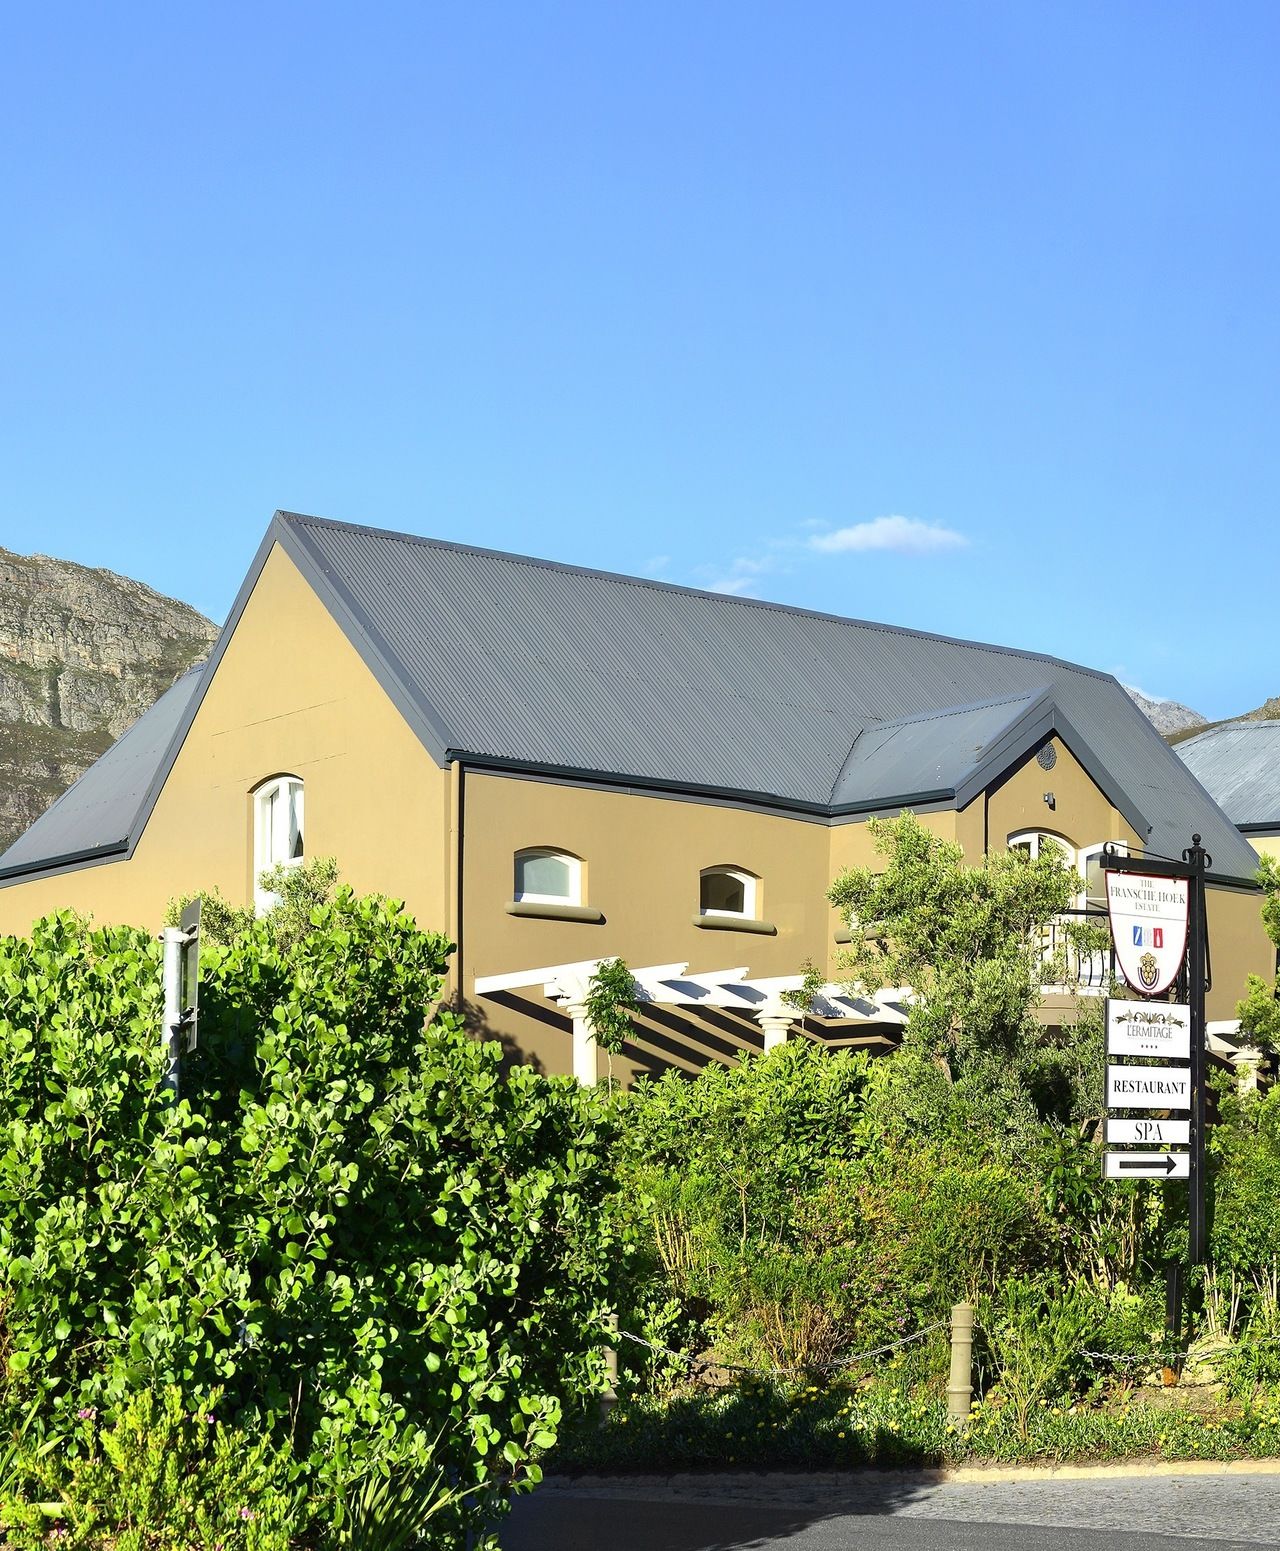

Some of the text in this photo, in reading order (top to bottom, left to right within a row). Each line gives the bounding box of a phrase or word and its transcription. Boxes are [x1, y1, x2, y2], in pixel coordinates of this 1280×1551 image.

[1140, 880, 1154, 888] THE
[1110, 886, 1186, 904] FRANSCHE HOEK
[1135, 902, 1160, 912] ESTATE
[1127, 1024, 1173, 1039] L'ERMITAGE
[1113, 1080, 1187, 1095] RESTAURANT
[1134, 1122, 1163, 1141] SPA
